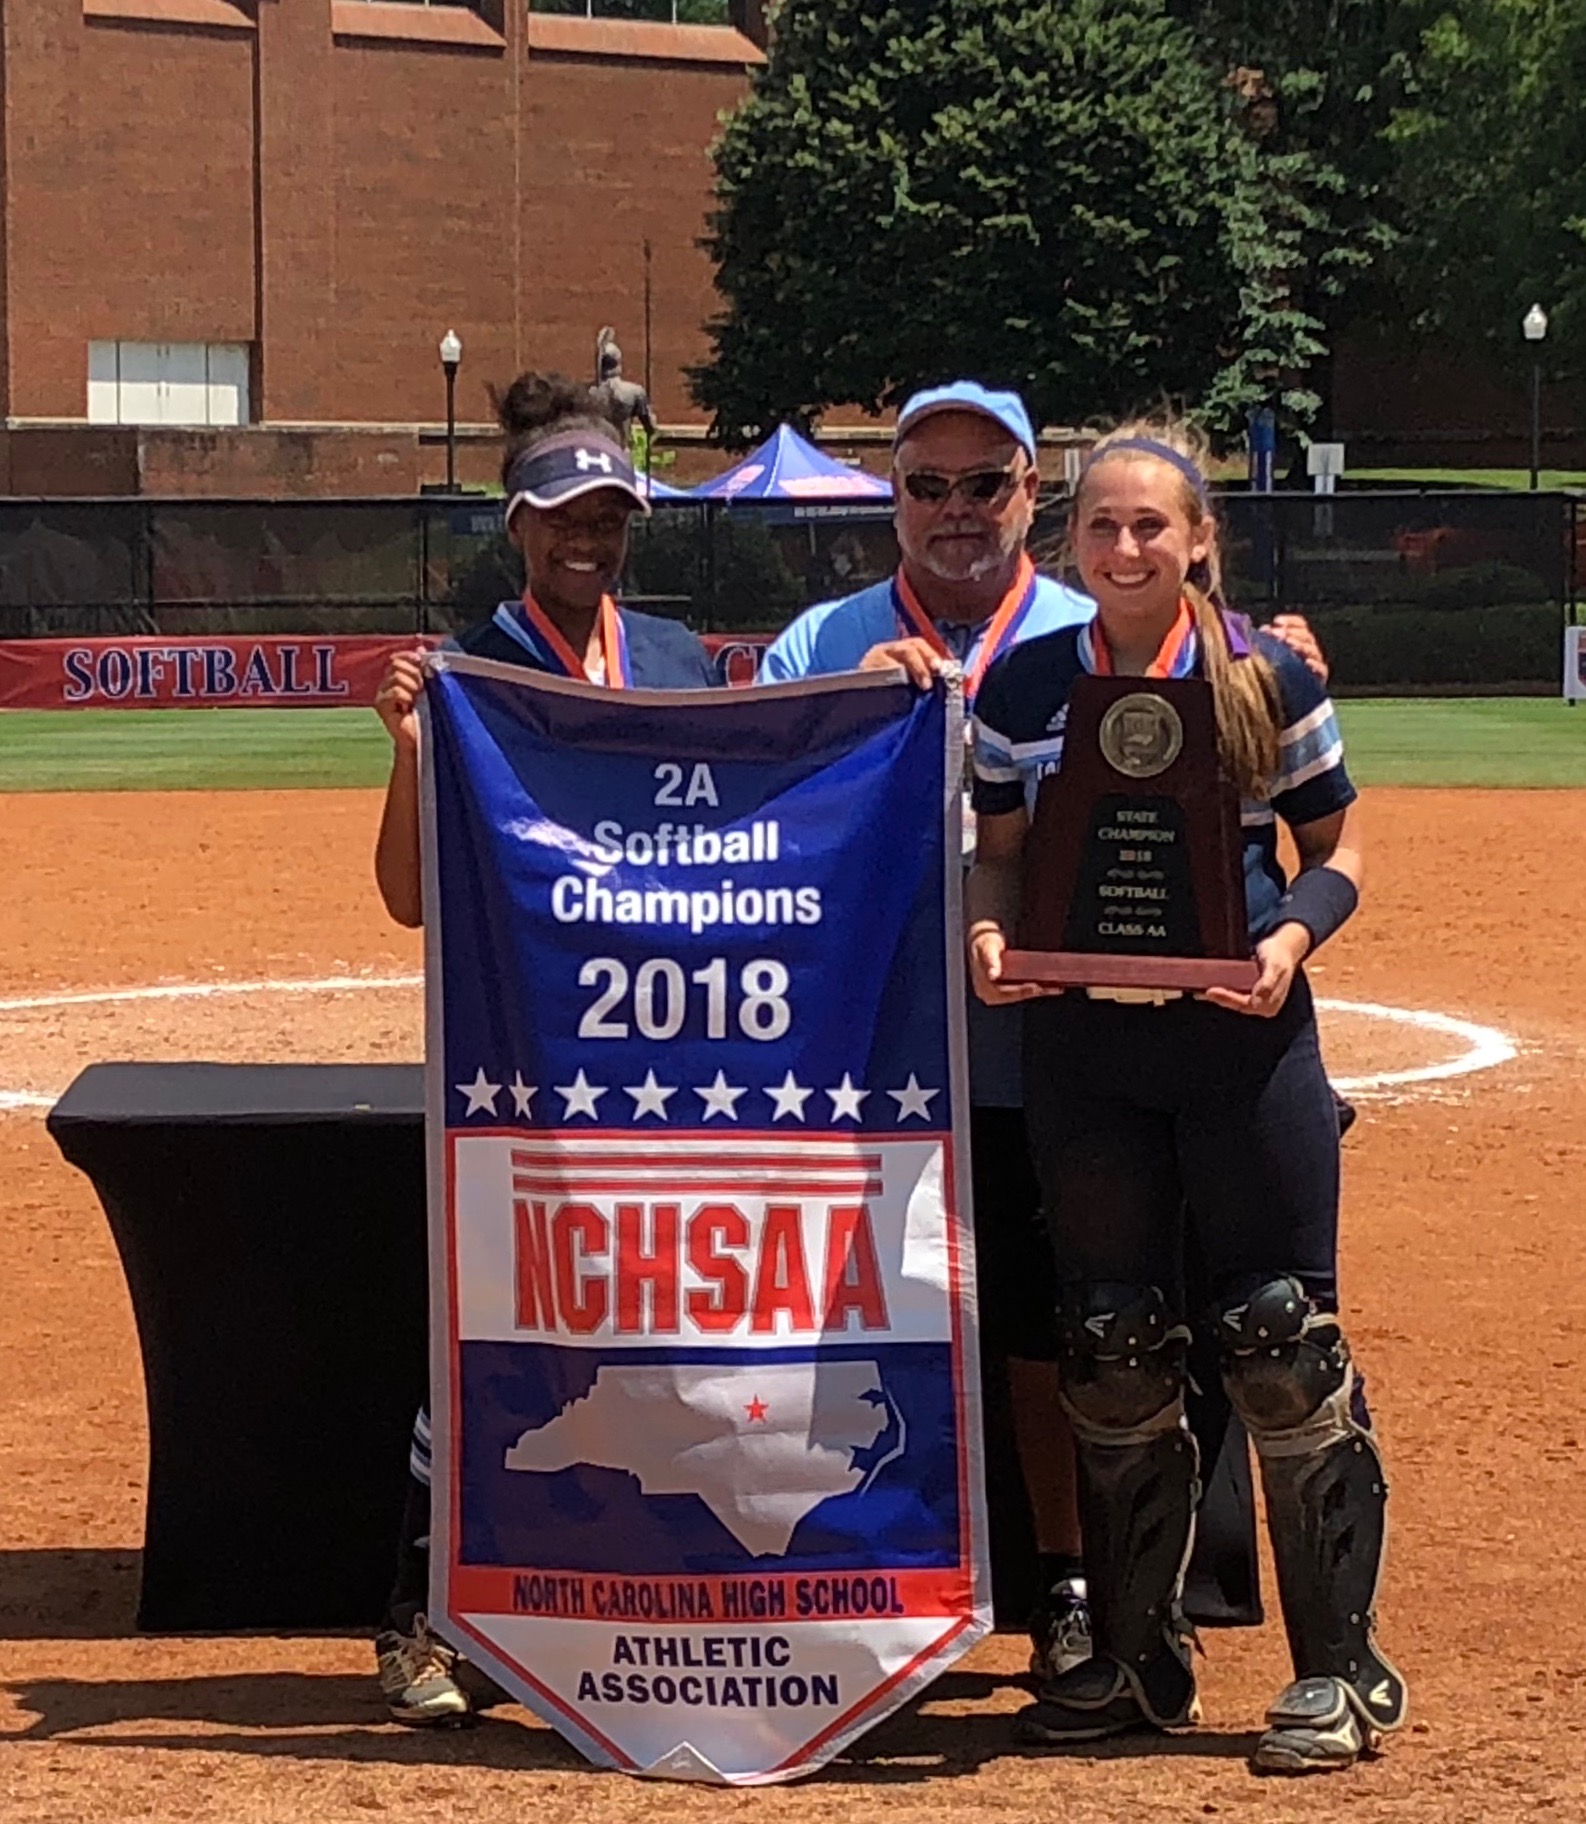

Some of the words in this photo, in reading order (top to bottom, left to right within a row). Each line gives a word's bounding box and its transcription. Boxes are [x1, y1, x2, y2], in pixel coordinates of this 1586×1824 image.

[63, 645, 348, 700] SOFTBALL
[654, 763, 719, 807] 2A
[1097, 827, 1175, 842] CHAMPION
[1116, 811, 1158, 823] STATE
[594, 821, 779, 866] Softball
[552, 875, 822, 934] Champions
[1098, 885, 1168, 899] SOFTBALL
[1098, 922, 1144, 936] CLASS
[1147, 925, 1167, 937] AA
[578, 957, 791, 1041] 2018
[513, 1199, 891, 1335] NCHSAA
[513, 1575, 585, 1614] NORTH
[592, 1580, 713, 1618] CAROLINA
[721, 1580, 786, 1617] HIGH
[796, 1577, 904, 1615] SCHOOL
[613, 1635, 791, 1667] ATHLETIC
[577, 1671, 840, 1707] ASSOCIATION
